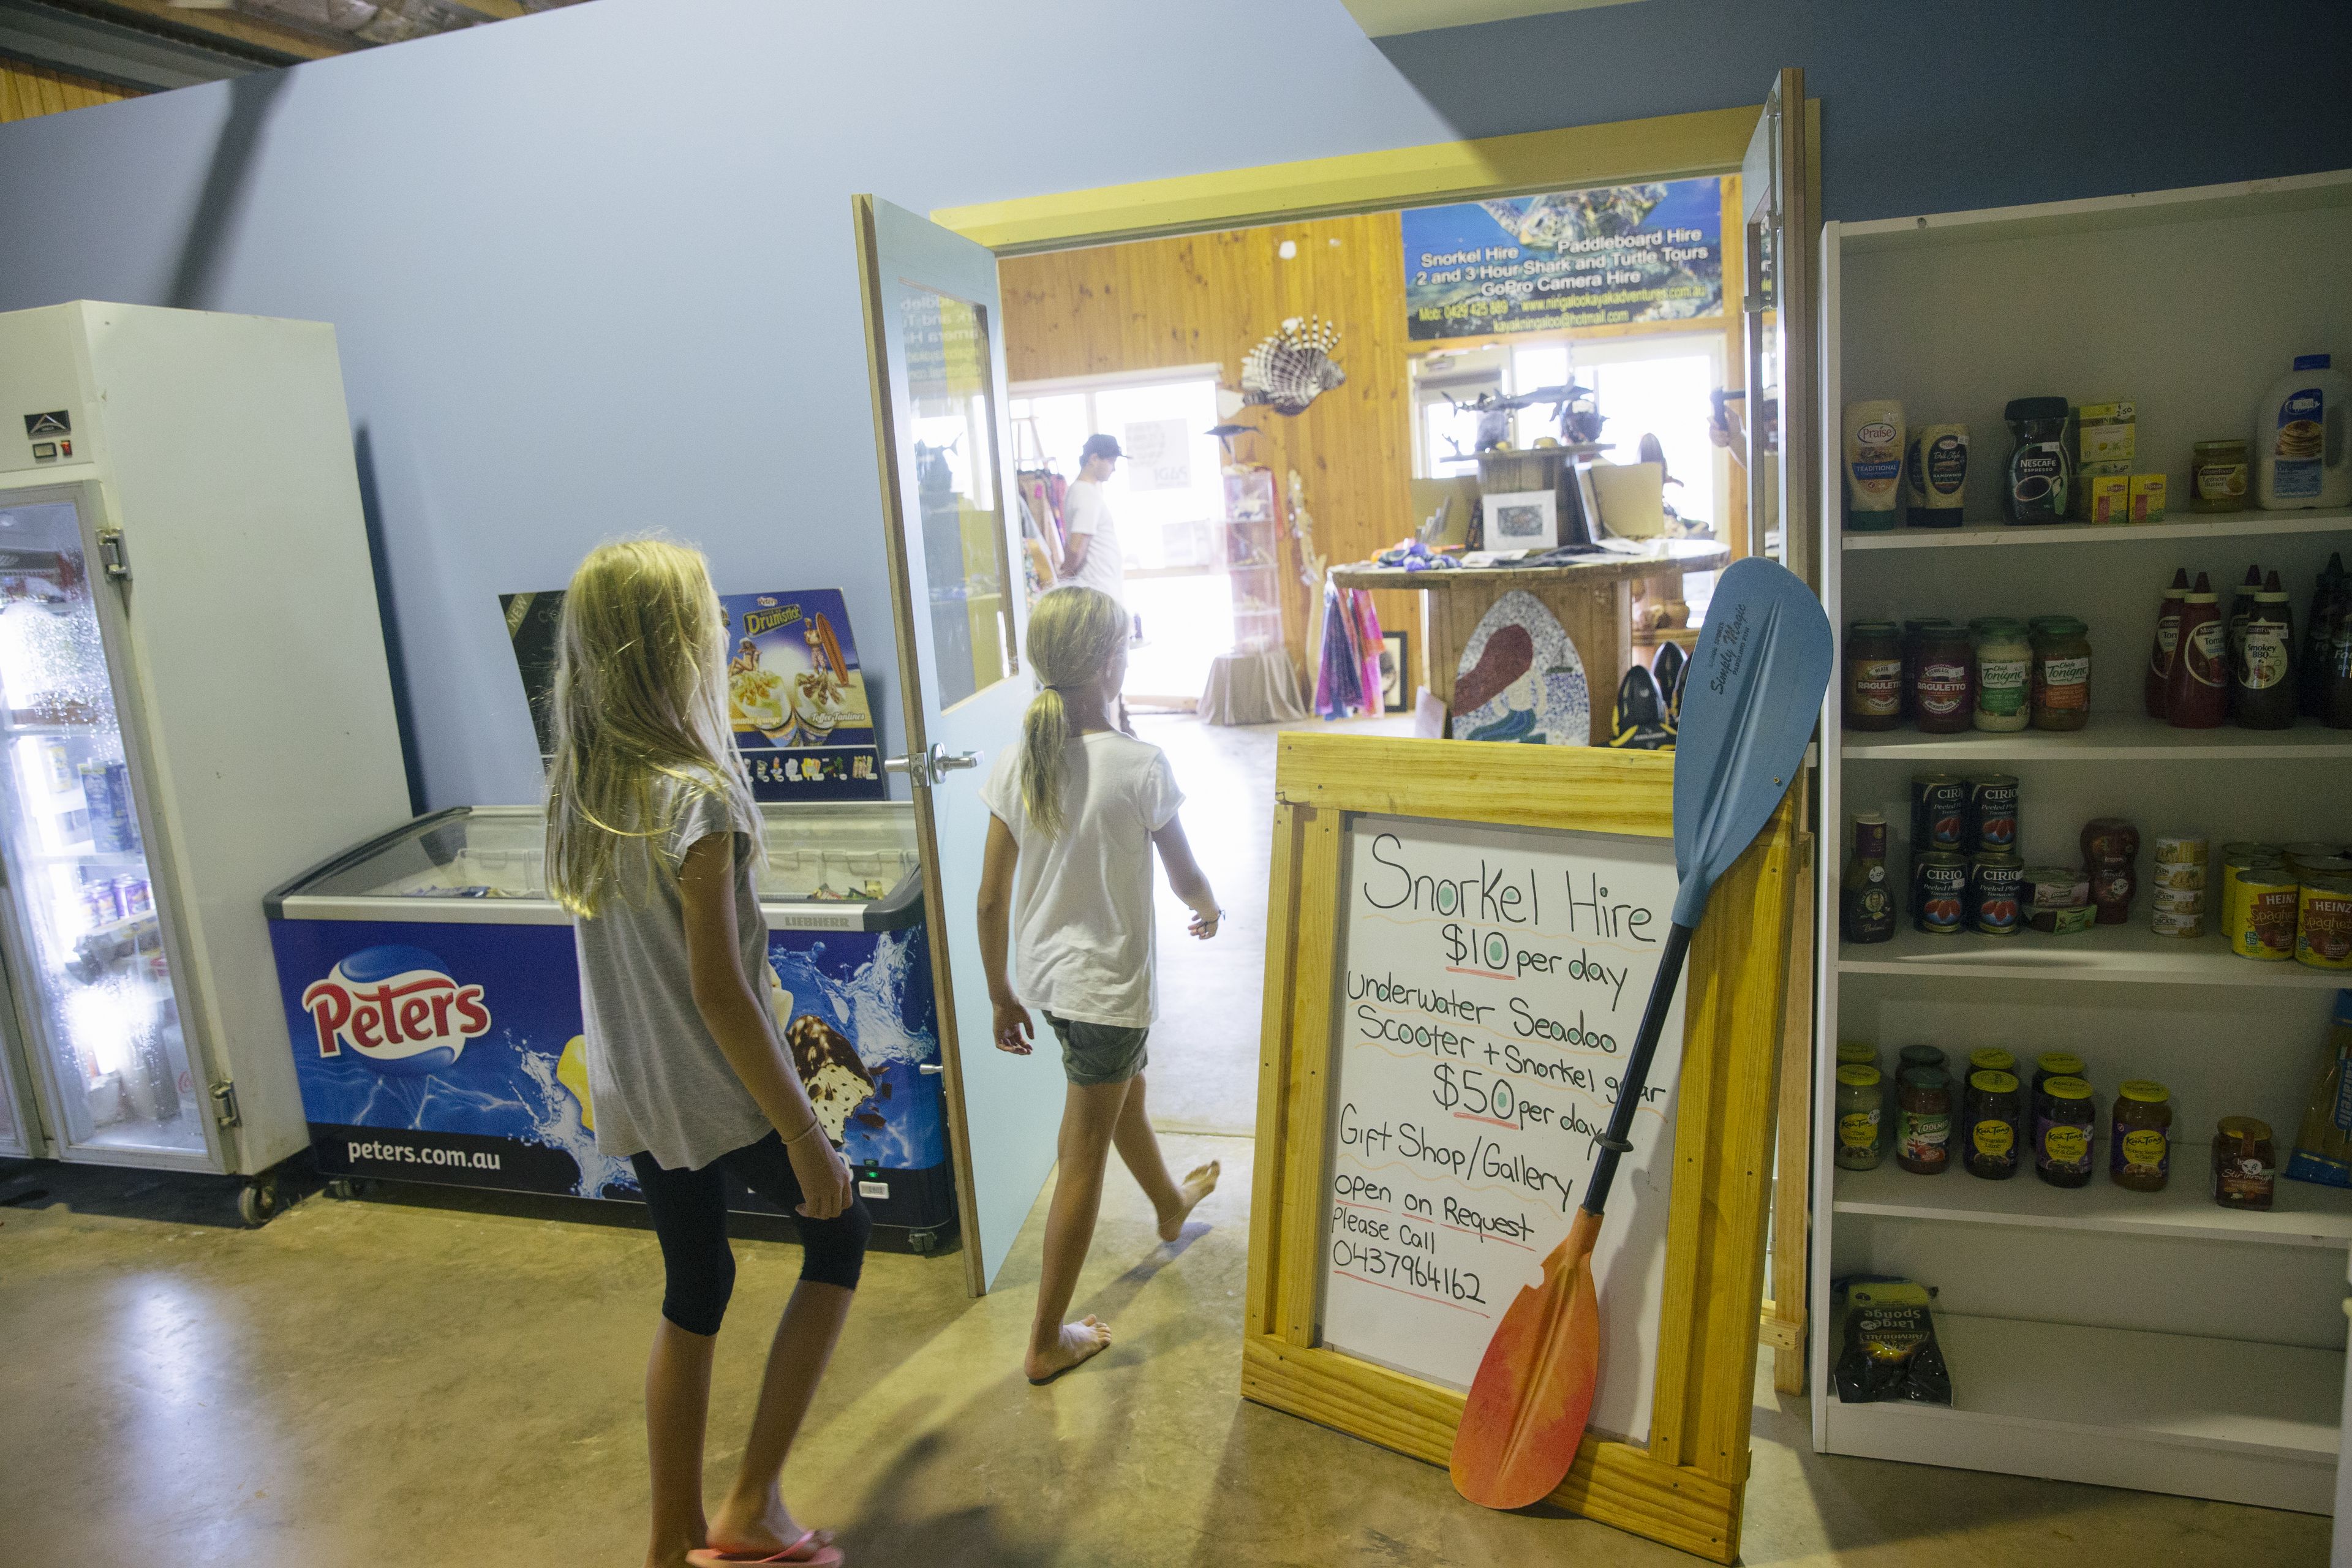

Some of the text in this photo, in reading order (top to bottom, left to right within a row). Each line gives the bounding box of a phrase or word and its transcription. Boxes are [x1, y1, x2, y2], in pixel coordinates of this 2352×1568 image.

[1558, 228, 1703, 254] Paddleboard Hire
[1417, 246, 1709, 286] 2 and 3 Hour Shark and Turtle Tours
[1420, 247, 1519, 268] Snorkel Hire
[1480, 271, 1642, 297] GoPro Camera Hire
[1863, 425, 1892, 439] Praise
[1856, 464, 1897, 472] TRADITIONAL
[507, 595, 527, 628] NEW
[746, 606, 799, 634] Drumstick
[1711, 603, 1746, 695] Simply Magic
[2247, 644, 2277, 654] Smokey
[1917, 682, 1966, 692] RAGULETTO
[1363, 832, 1657, 943] Snorkel Hire
[1926, 869, 1962, 880] CIRIO
[2266, 893, 2297, 905] HEINZ
[2315, 900, 2352, 914] HEINZ
[785, 916, 850, 927] LIEBHERR
[1442, 922, 1629, 1012] $10 per day
[305, 977, 489, 1054] Peters
[1347, 970, 1618, 1054] Underwater Seadoo
[1357, 1005, 1476, 1058] Scooter
[1504, 1044, 1596, 1093] Snorkel
[1604, 1076, 1667, 1104] gar
[1432, 1062, 1603, 1161] $50 per day
[1340, 1102, 1393, 1157] Gift
[347, 1140, 502, 1170] peters.com.au
[2222, 1168, 2243, 1178] Stir
[1331, 1207, 1435, 1254] Please Call
[1403, 1193, 1433, 1216] on
[1444, 1196, 1535, 1244] Request
[1332, 1239, 1487, 1305] 0437964162
[1864, 1309, 1921, 1319] Sponge
[1877, 1319, 1915, 1329] Large
